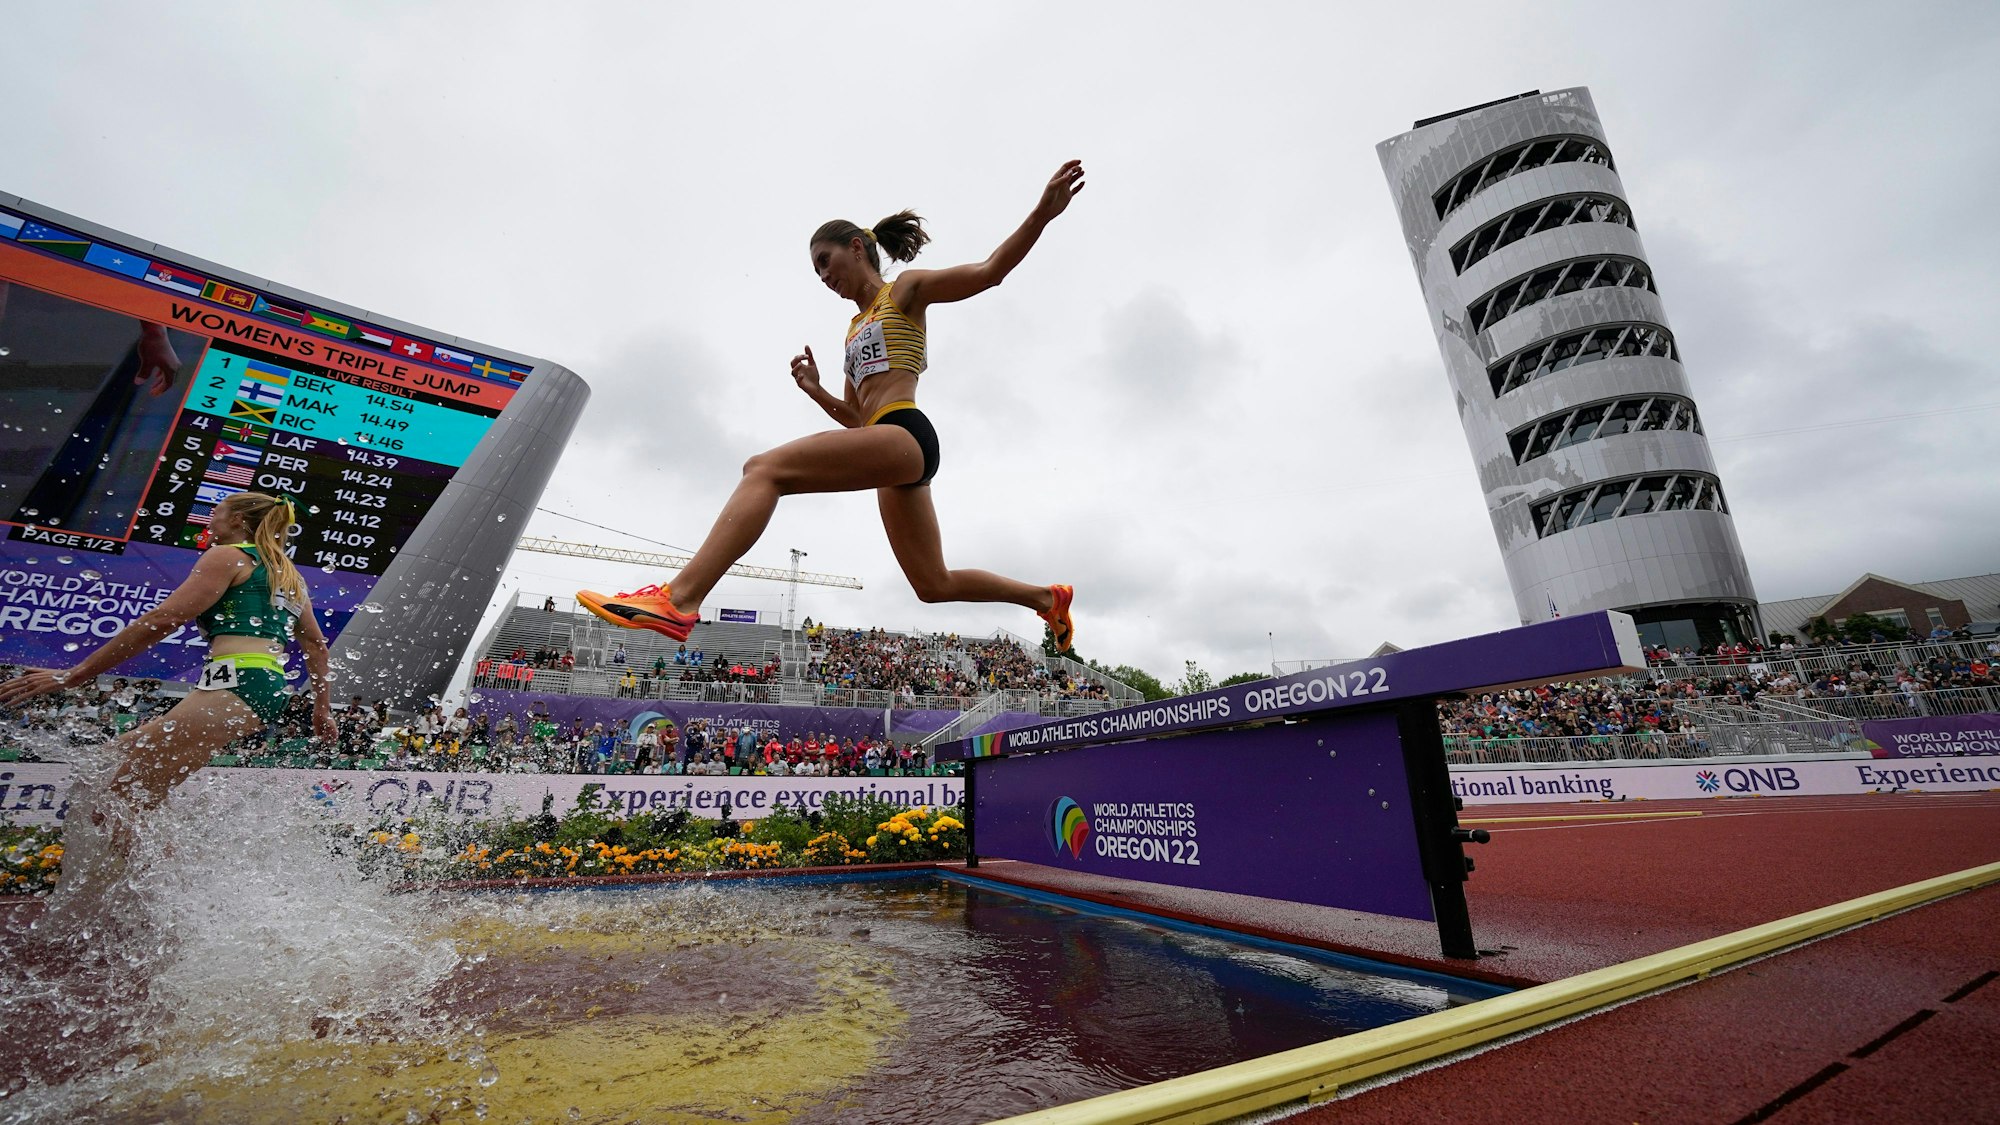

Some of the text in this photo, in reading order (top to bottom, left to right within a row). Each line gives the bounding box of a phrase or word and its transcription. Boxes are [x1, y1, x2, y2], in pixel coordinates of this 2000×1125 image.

[171, 302, 481, 398] WOMEN'S TRIPLE JUMP
[221, 357, 415, 414] 1 BEK 14.54
[326, 369, 417, 399] LIVE RESULT
[200, 396, 404, 450] 3 RIC 14.46
[209, 376, 410, 432] 2 MAK 14.49
[191, 416, 399, 470] 4 LAF 14.39
[183, 436, 393, 489] 5 PER 14.24
[174, 457, 387, 509] 6 ORJ 14.23
[169, 479, 382, 529] 7 14.12
[21, 529, 116, 551] PAGE 1/2
[156, 501, 176, 517] 8
[321, 529, 376, 549] 14.09
[149, 524, 166, 540] 9
[314, 550, 370, 570] 14.05
[86, 580, 174, 603] ATHLE
[204, 664, 231, 687] 14
[726, 718, 780, 728] ATHLETICS
[1008, 729, 1040, 748] WORLD
[1041, 719, 1098, 743] ATHLETICS
[1101, 696, 1231, 735] CHAMPIONSHIPS
[1892, 732, 1952, 744] WORLD
[1898, 740, 2000, 755] CHAMPION
[1519, 774, 1614, 800] banking
[1724, 767, 1800, 792] QNB
[1093, 803, 1195, 818] WORLD ATHLETICS
[1094, 818, 1197, 838] CHAMPIONSHIPS
